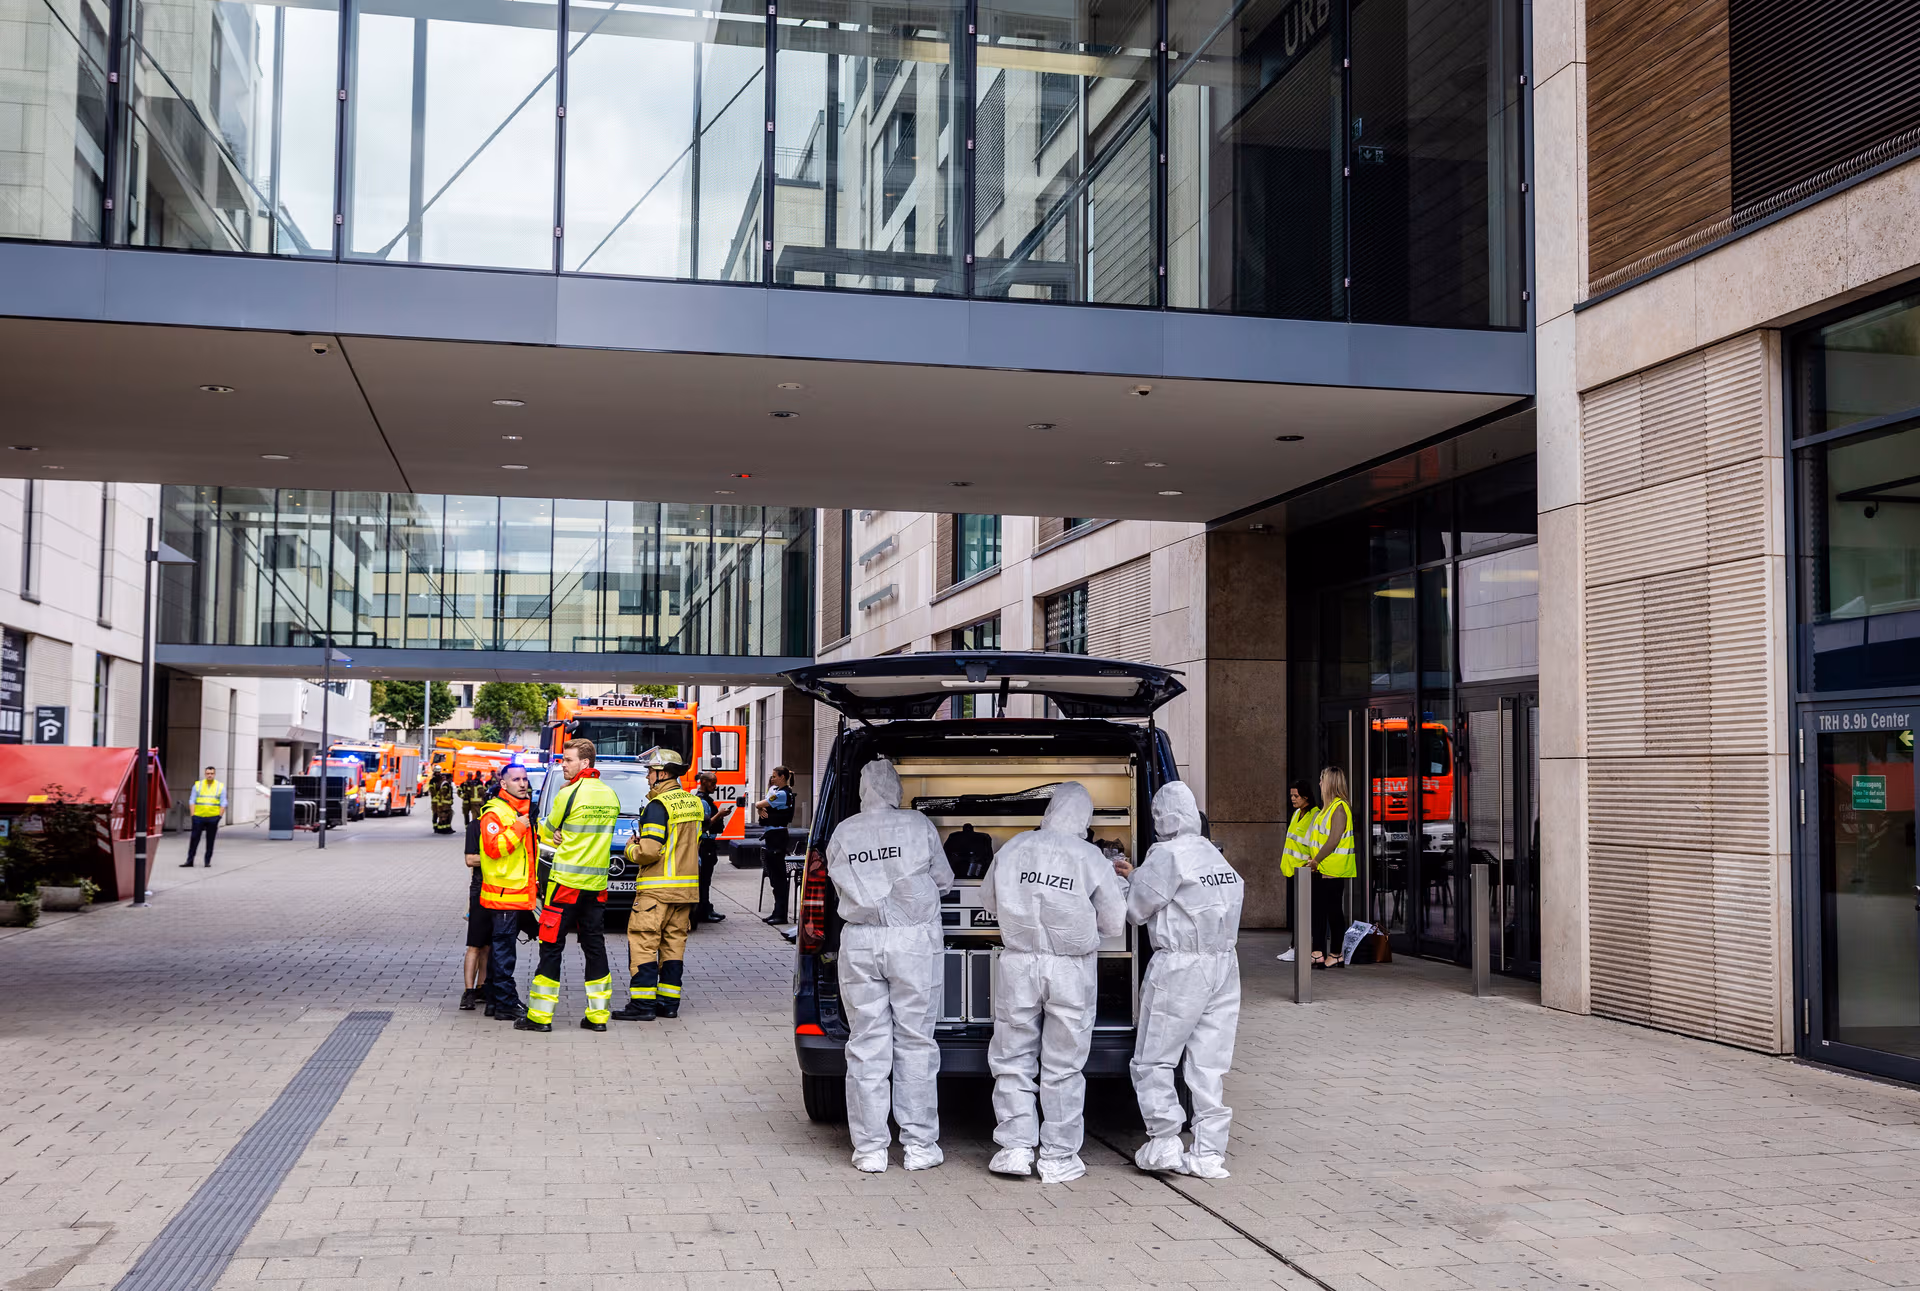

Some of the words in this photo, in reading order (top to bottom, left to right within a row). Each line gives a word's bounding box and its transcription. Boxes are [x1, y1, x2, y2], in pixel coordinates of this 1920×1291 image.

[602, 699, 664, 708] FEUERWEHR
[1819, 714, 1839, 731] TRH
[1842, 713, 1867, 730] 8.9b
[1871, 712, 1910, 729] Center
[43, 725, 58, 742] P
[715, 786, 736, 800] 112
[848, 846, 902, 866] POLIZEI
[1019, 871, 1074, 891] POLIZEI
[1199, 872, 1238, 887] POIZEI
